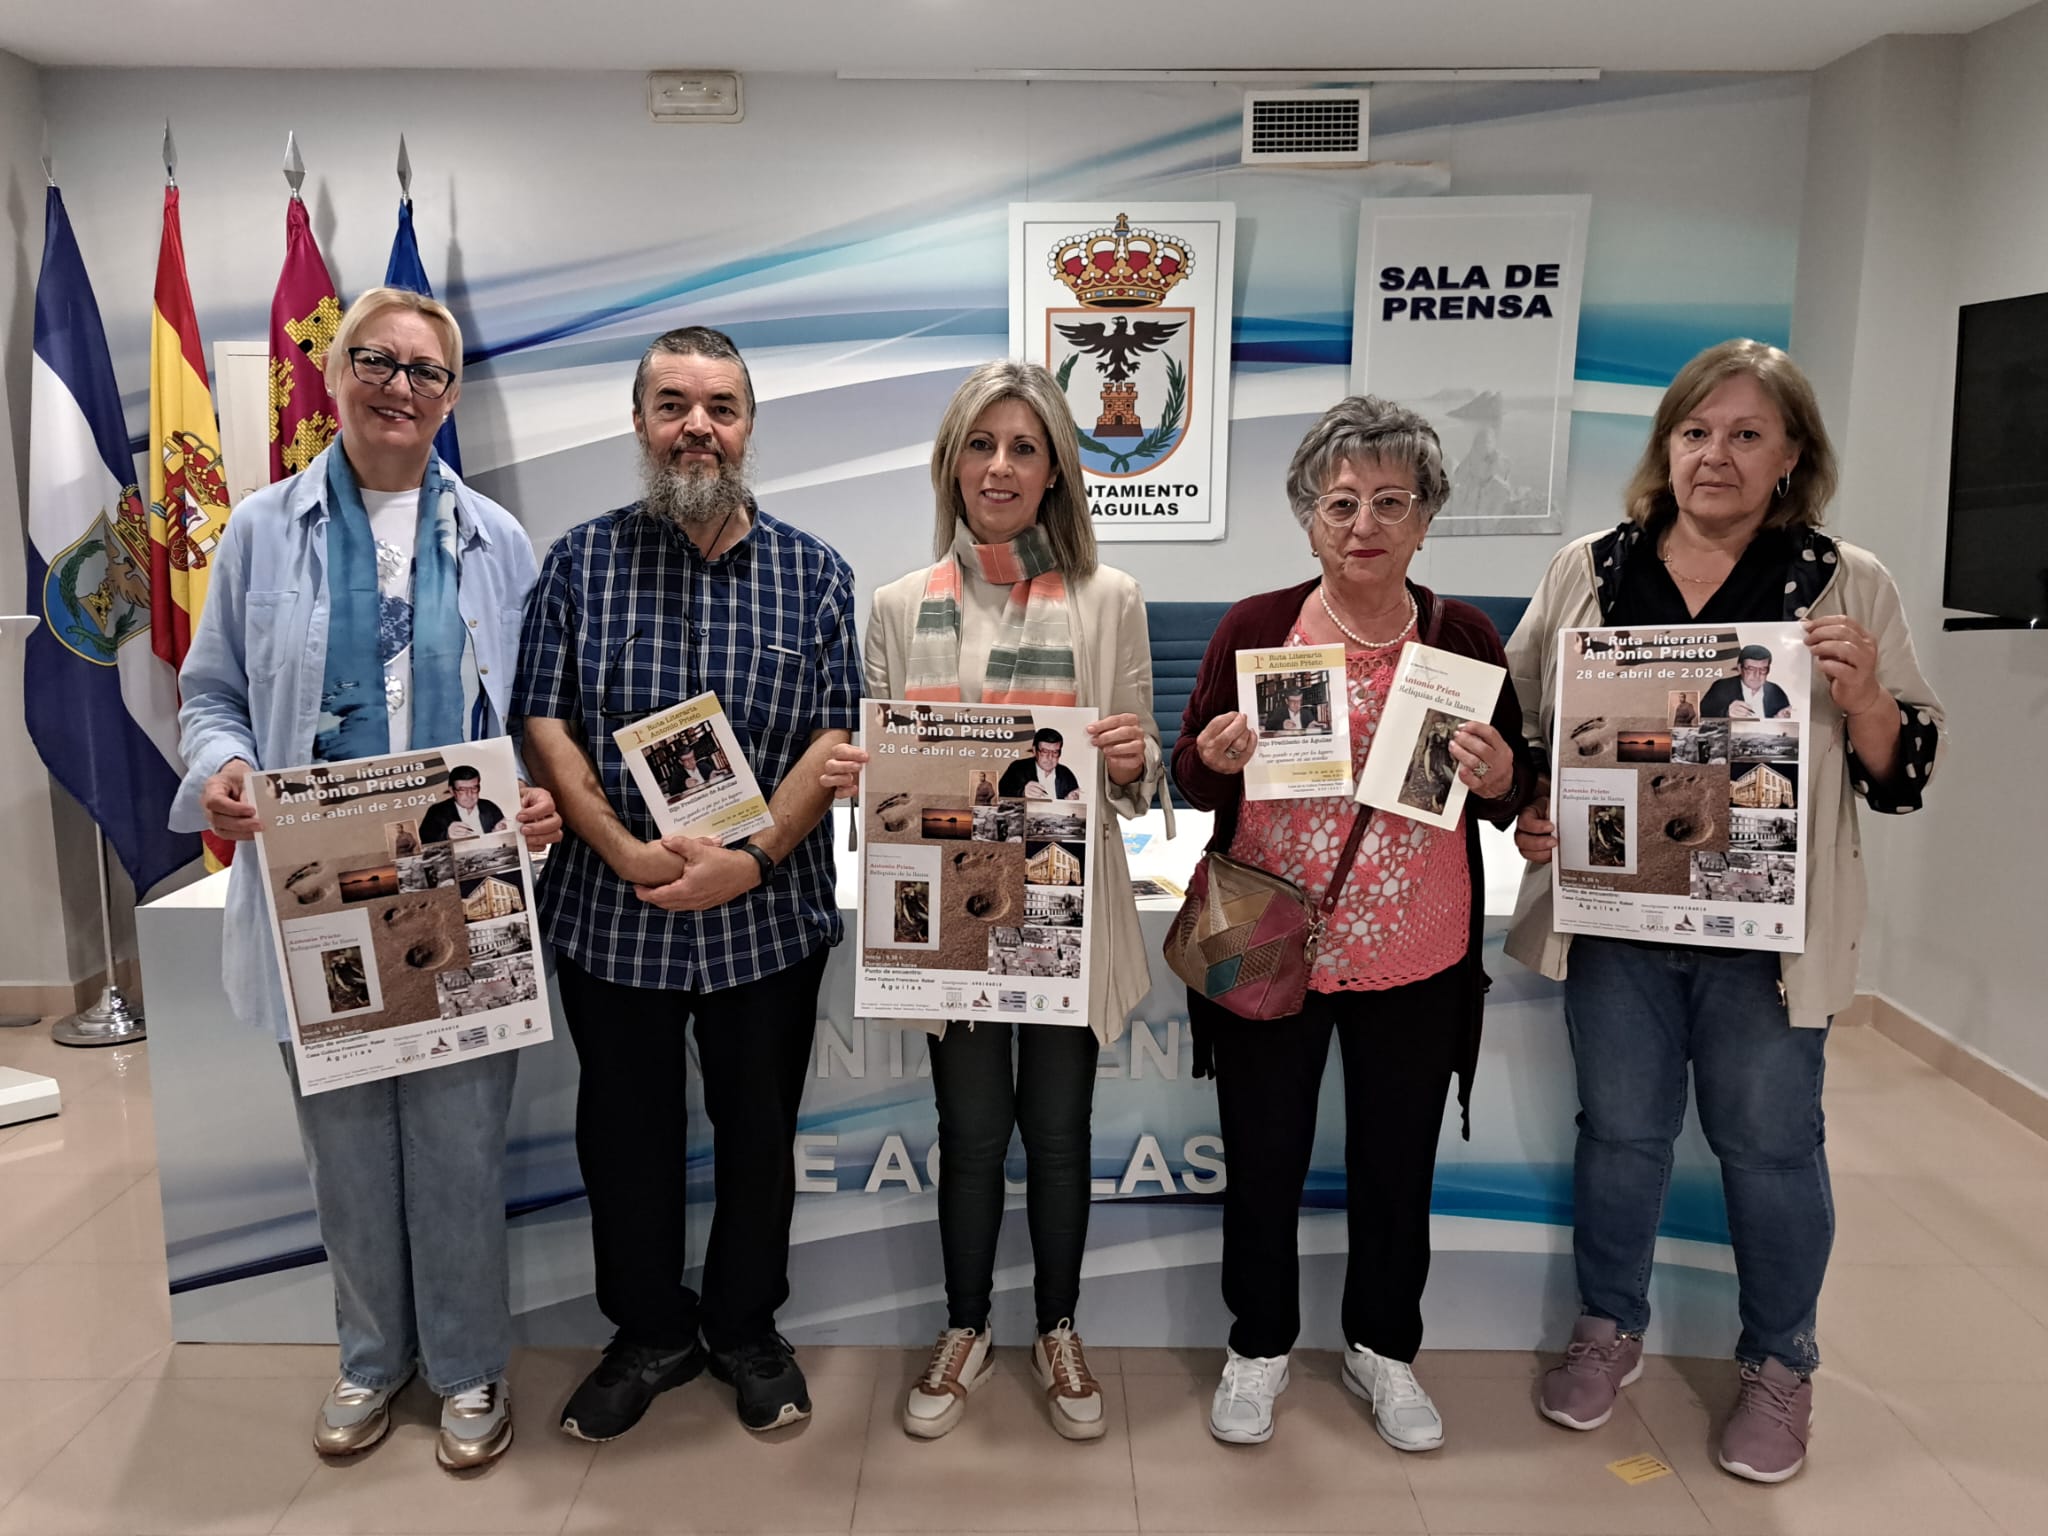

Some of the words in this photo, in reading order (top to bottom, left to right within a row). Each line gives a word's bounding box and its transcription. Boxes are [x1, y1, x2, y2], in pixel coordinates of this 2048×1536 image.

[1380, 266, 1490, 291] SALA
[1505, 264, 1560, 288] DE
[1382, 295, 1552, 321] PRENSA
[1085, 484, 1198, 498] NTAMIENTO
[1608, 636, 1643, 646] Ruta
[1653, 634, 1717, 646] literaria
[1584, 648, 1653, 660] Antonio
[1660, 647, 1717, 659] Prieto
[1576, 669, 1592, 680] 28
[1598, 670, 1615, 679] de
[1620, 669, 1652, 679] abril
[1658, 668, 1675, 678] de
[1681, 668, 1723, 678] 2.024
[1436, 684, 1460, 697] Prieto
[1435, 696, 1445, 704] de
[910, 710, 944, 721] Ruta
[954, 712, 1015, 724] literaria
[886, 722, 954, 737] Antonio
[960, 725, 1014, 739] Prieto
[879, 743, 895, 753] 28
[901, 745, 917, 754] de
[922, 746, 954, 756] abril
[959, 747, 976, 756] de
[981, 748, 1020, 758] 2.024
[305, 772, 345, 786] Ruta
[356, 761, 425, 780] literaria
[279, 785, 359, 805] Antonio
[365, 775, 426, 793] Prieto
[275, 815, 295, 826] 28
[301, 812, 320, 823] de
[326, 805, 363, 819] abril
[368, 802, 388, 813] de
[393, 793, 437, 809] 2.024
[795, 1134, 838, 1193] E
